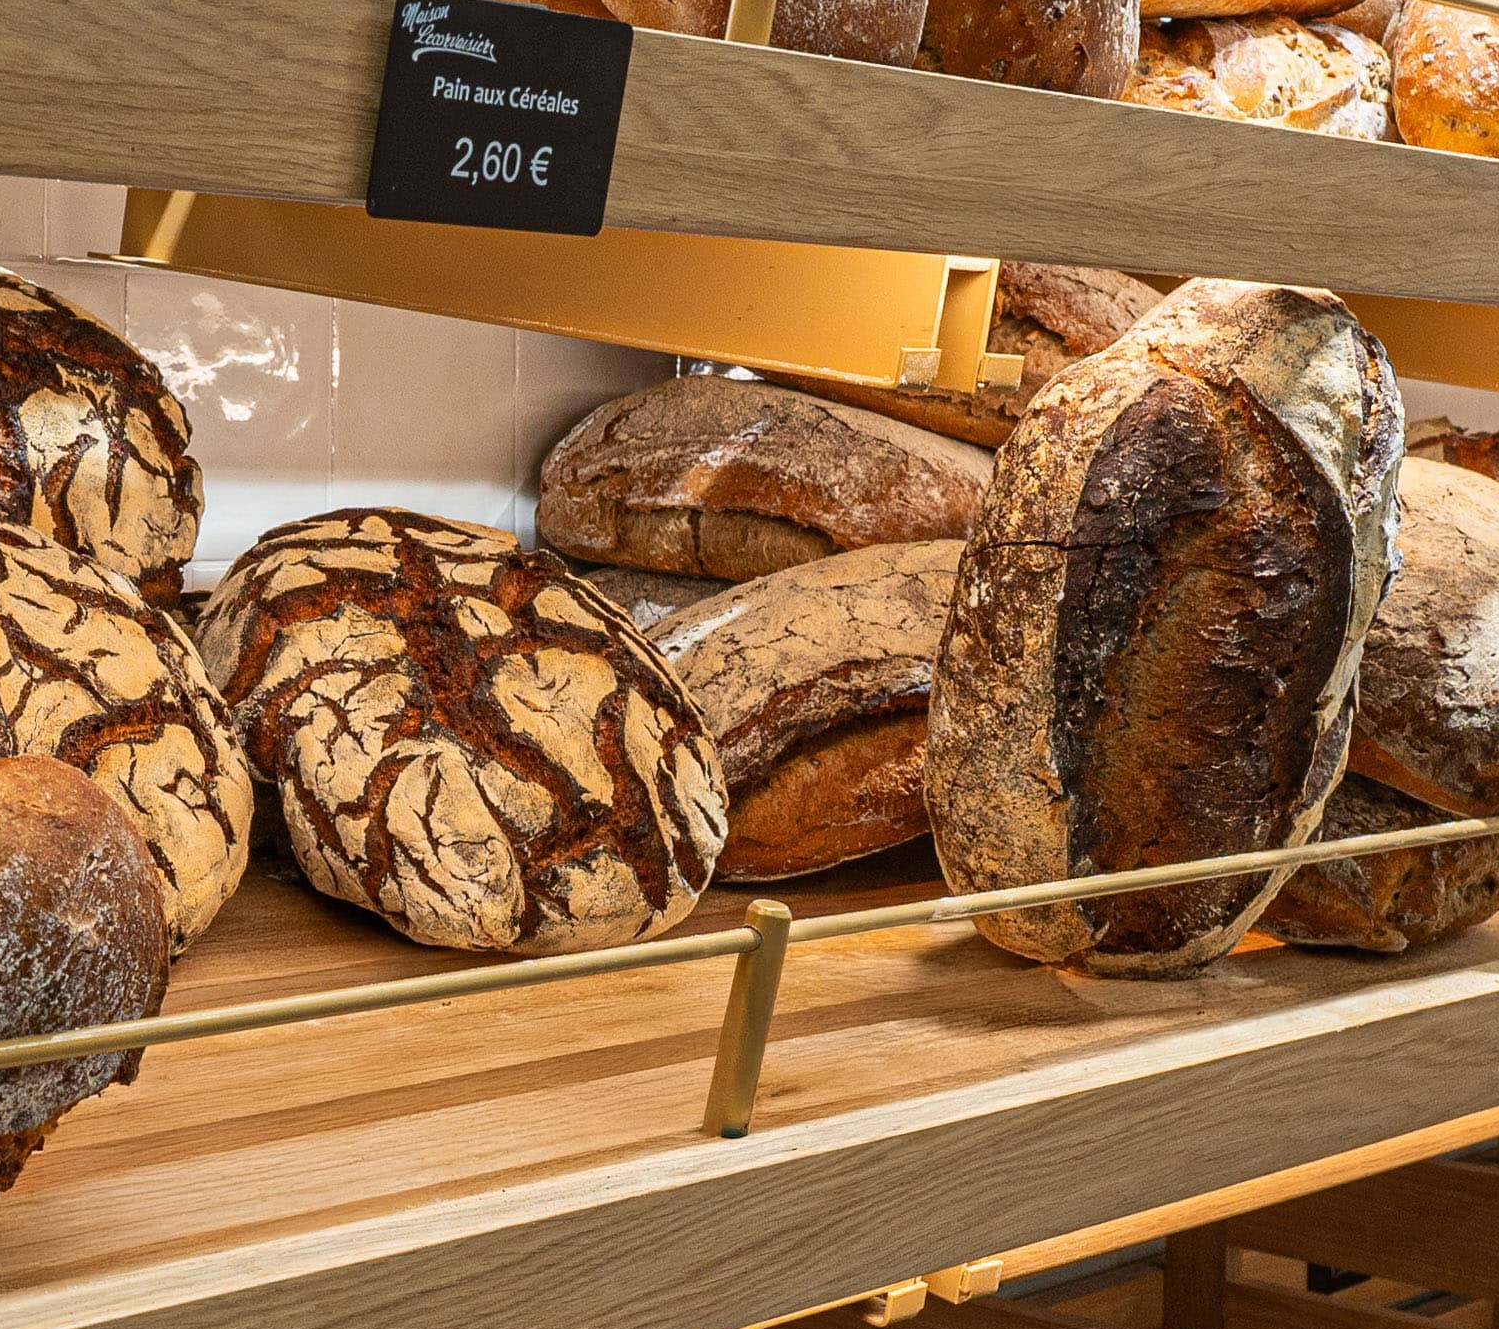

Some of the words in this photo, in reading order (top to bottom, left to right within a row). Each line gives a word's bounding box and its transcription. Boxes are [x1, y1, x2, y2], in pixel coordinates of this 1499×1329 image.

[401, 1, 450, 32] Maison
[432, 76, 470, 101] Pain
[473, 87, 506, 107] aux
[509, 86, 579, 115] Céréales
[450, 137, 521, 186] 2,60
[529, 146, 553, 186] €
